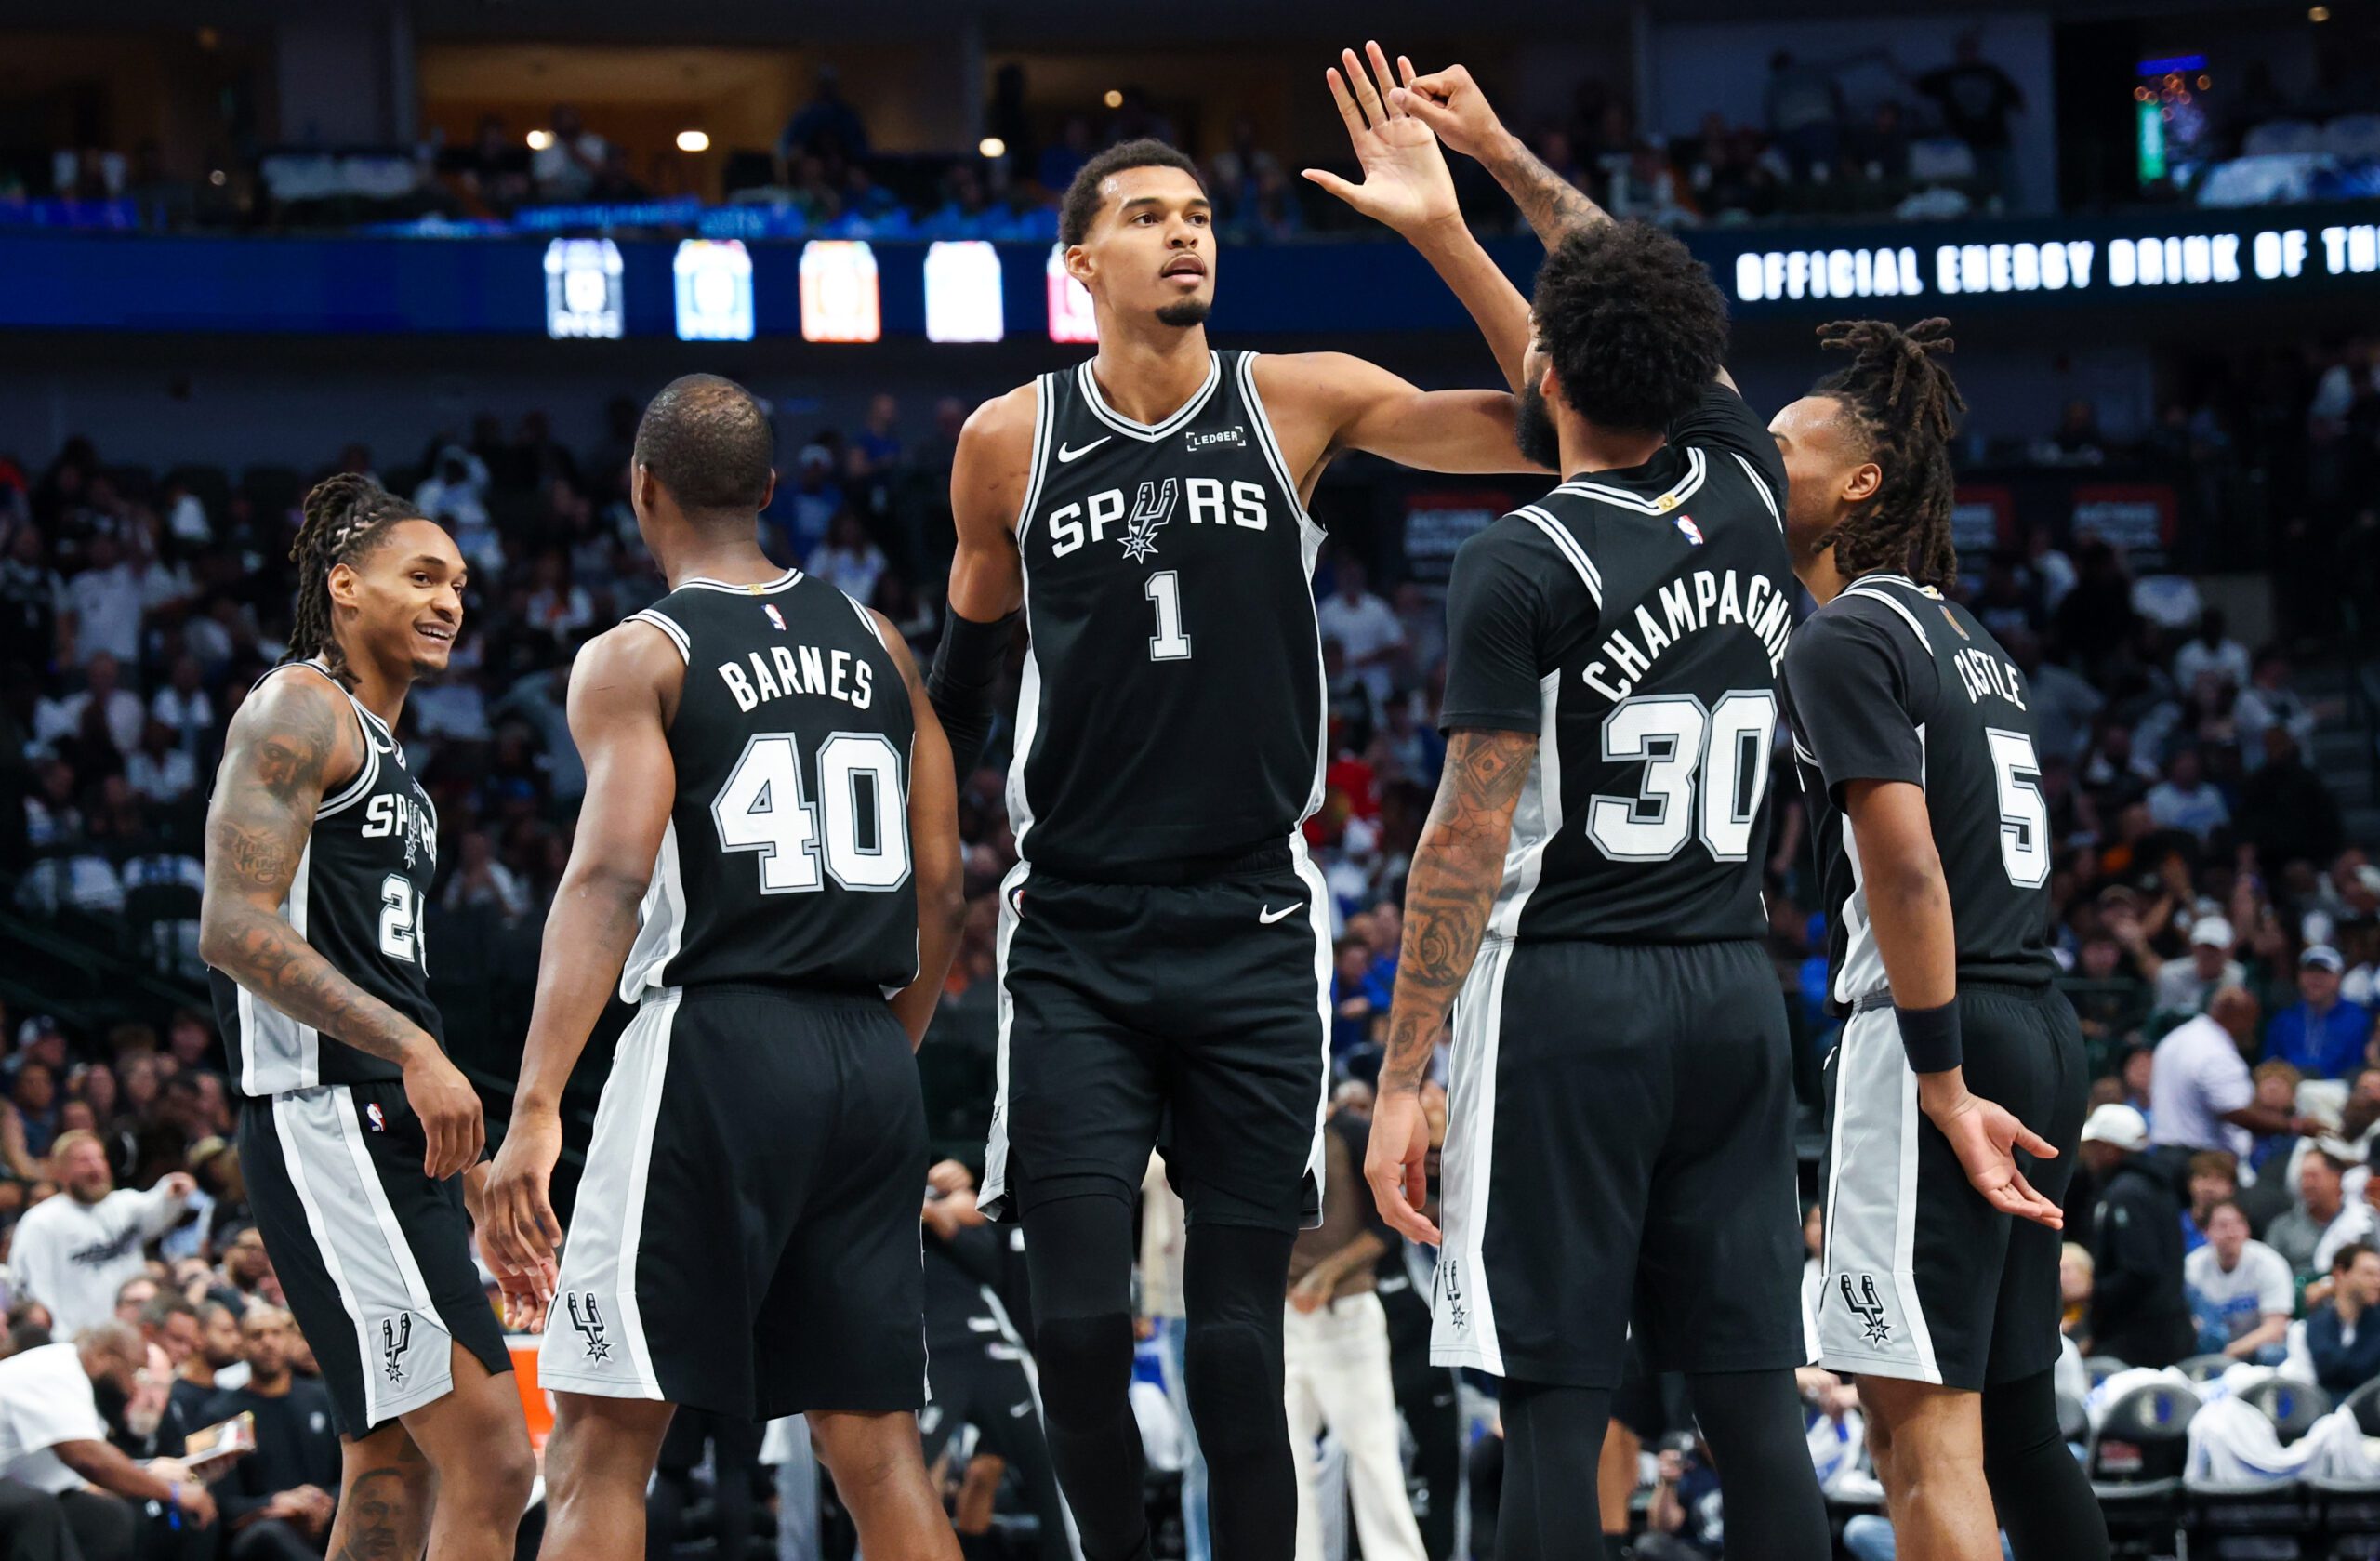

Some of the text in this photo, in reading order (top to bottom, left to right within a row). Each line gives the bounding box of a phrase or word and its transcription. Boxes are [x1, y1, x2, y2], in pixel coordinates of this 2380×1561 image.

[1736, 224, 2380, 301] OFFICIAL ENERGY DRINK OF TH
[1194, 430, 1238, 446] LEDGER
[1049, 477, 1268, 564] SPURS
[1144, 569, 1192, 662] 1
[718, 645, 873, 713] BARNES
[1953, 647, 2027, 712] CASTLE
[710, 730, 912, 895] 40
[1585, 688, 1778, 863] 30
[1985, 726, 2052, 890] 5
